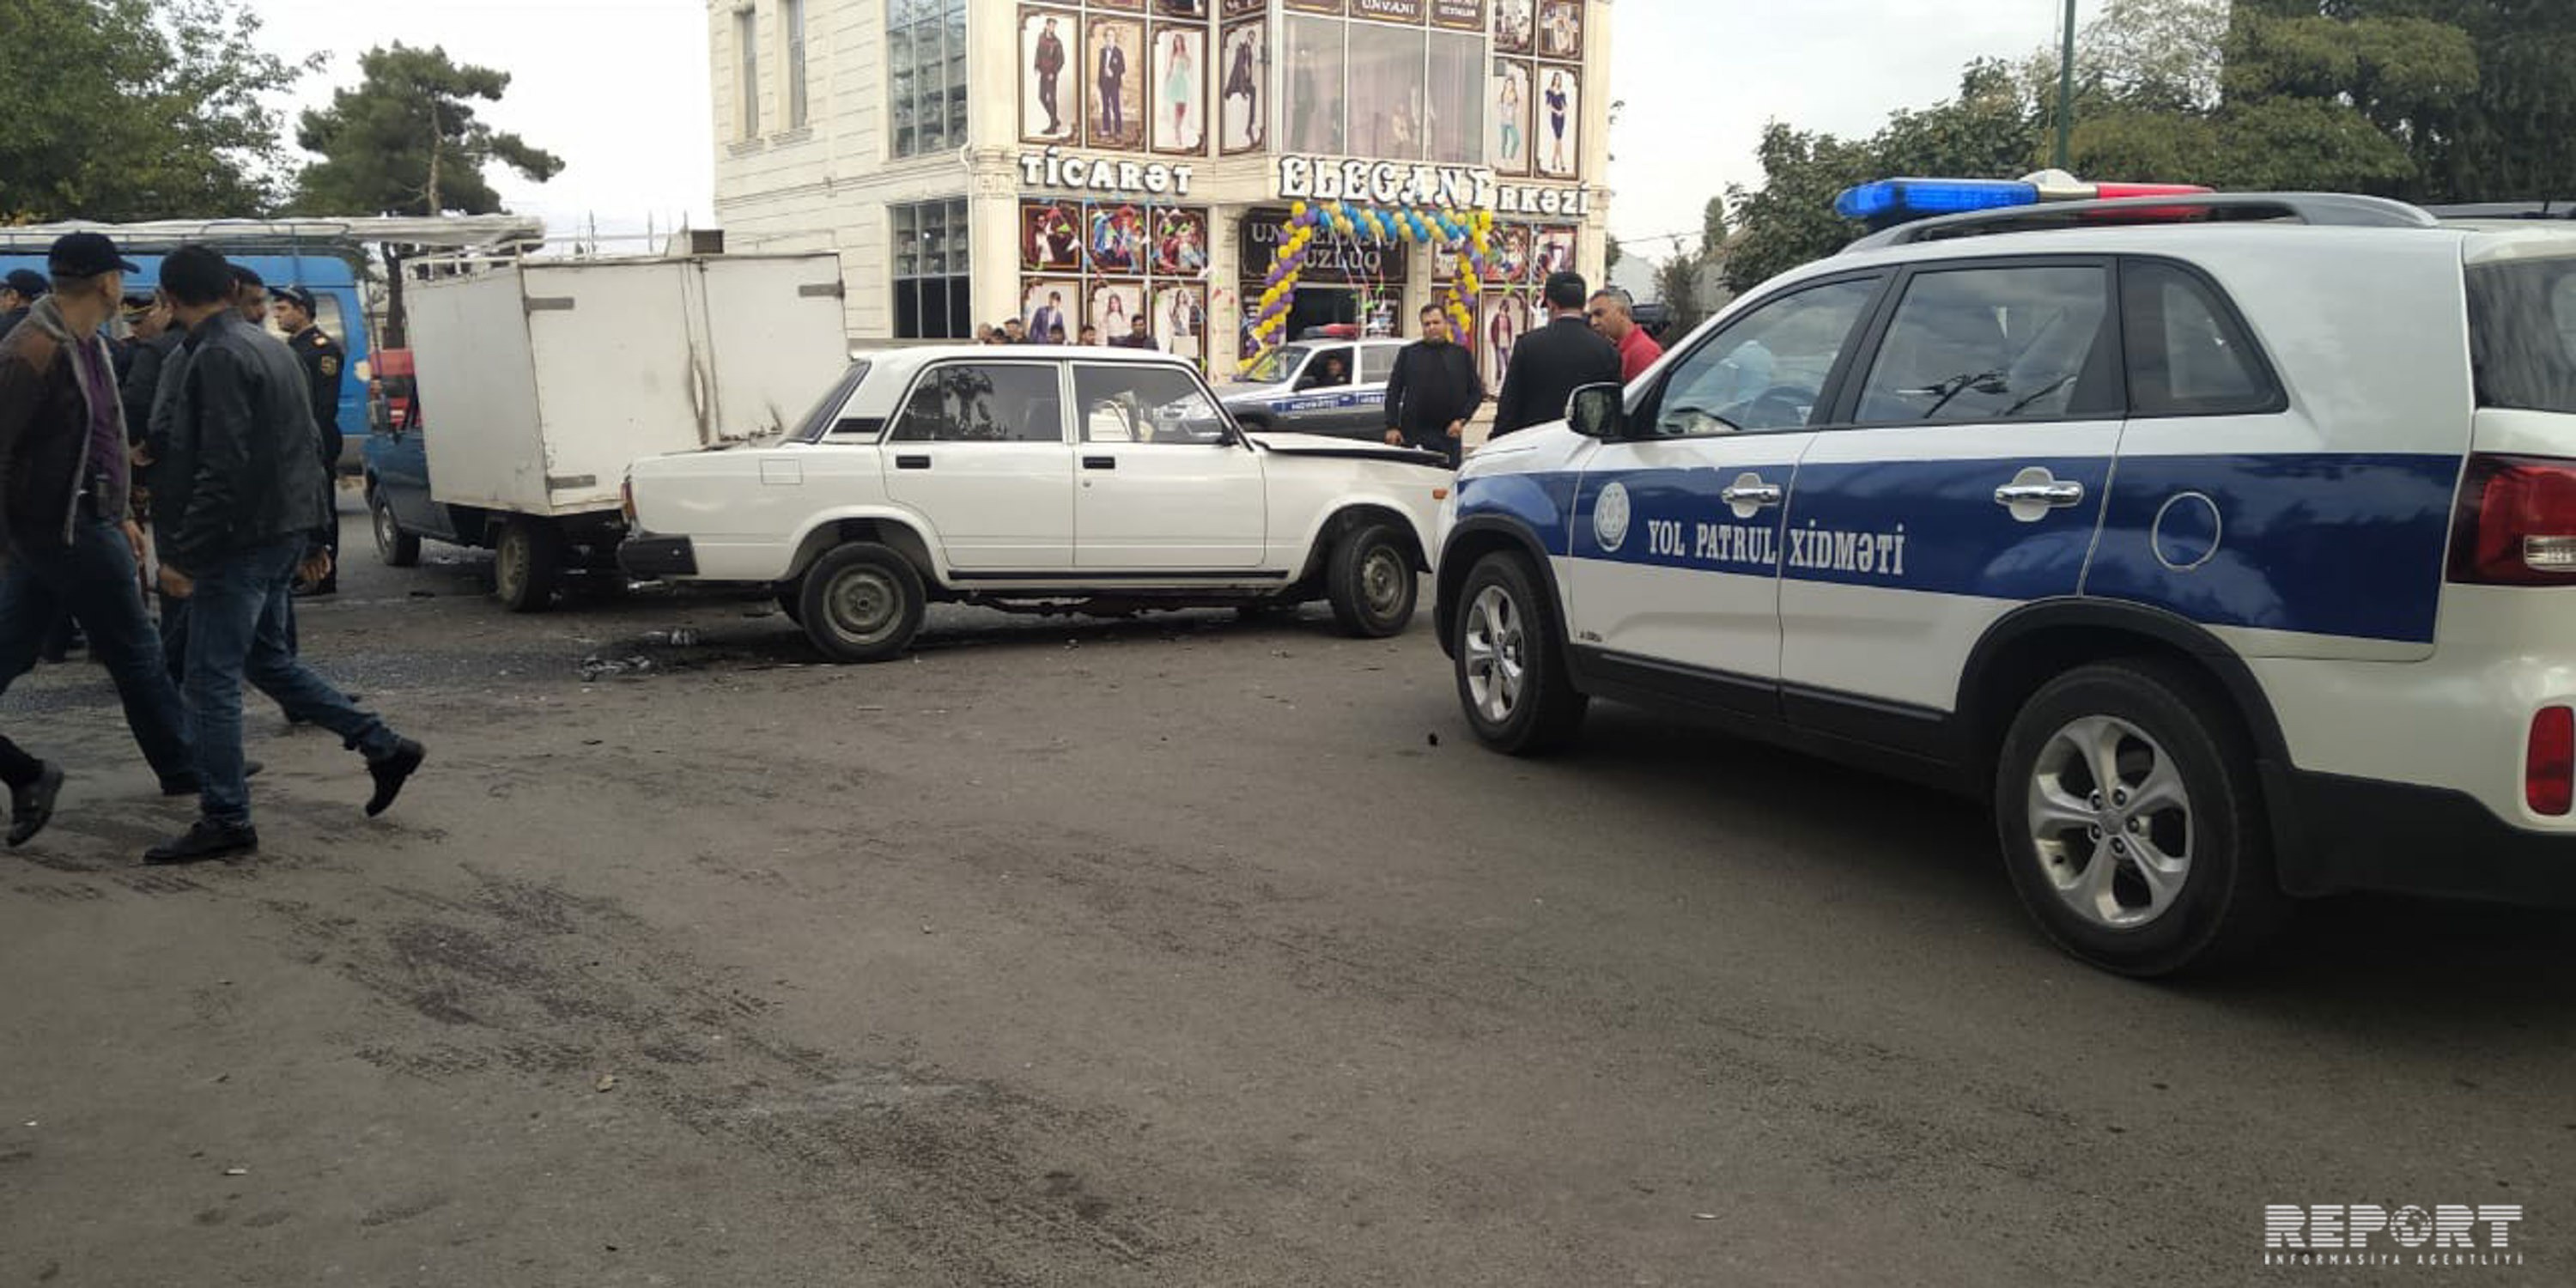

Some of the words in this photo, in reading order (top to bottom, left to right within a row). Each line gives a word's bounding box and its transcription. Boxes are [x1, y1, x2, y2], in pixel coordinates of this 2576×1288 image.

[1020, 144, 1194, 195] TİCARƏT
[1498, 180, 1589, 216] RKƏZİ
[1279, 155, 1495, 208] ELEGANT
[1647, 520, 1686, 557] YOL
[1694, 523, 1777, 565] PATRUL
[1788, 519, 1906, 576] XİDMƏTİ
